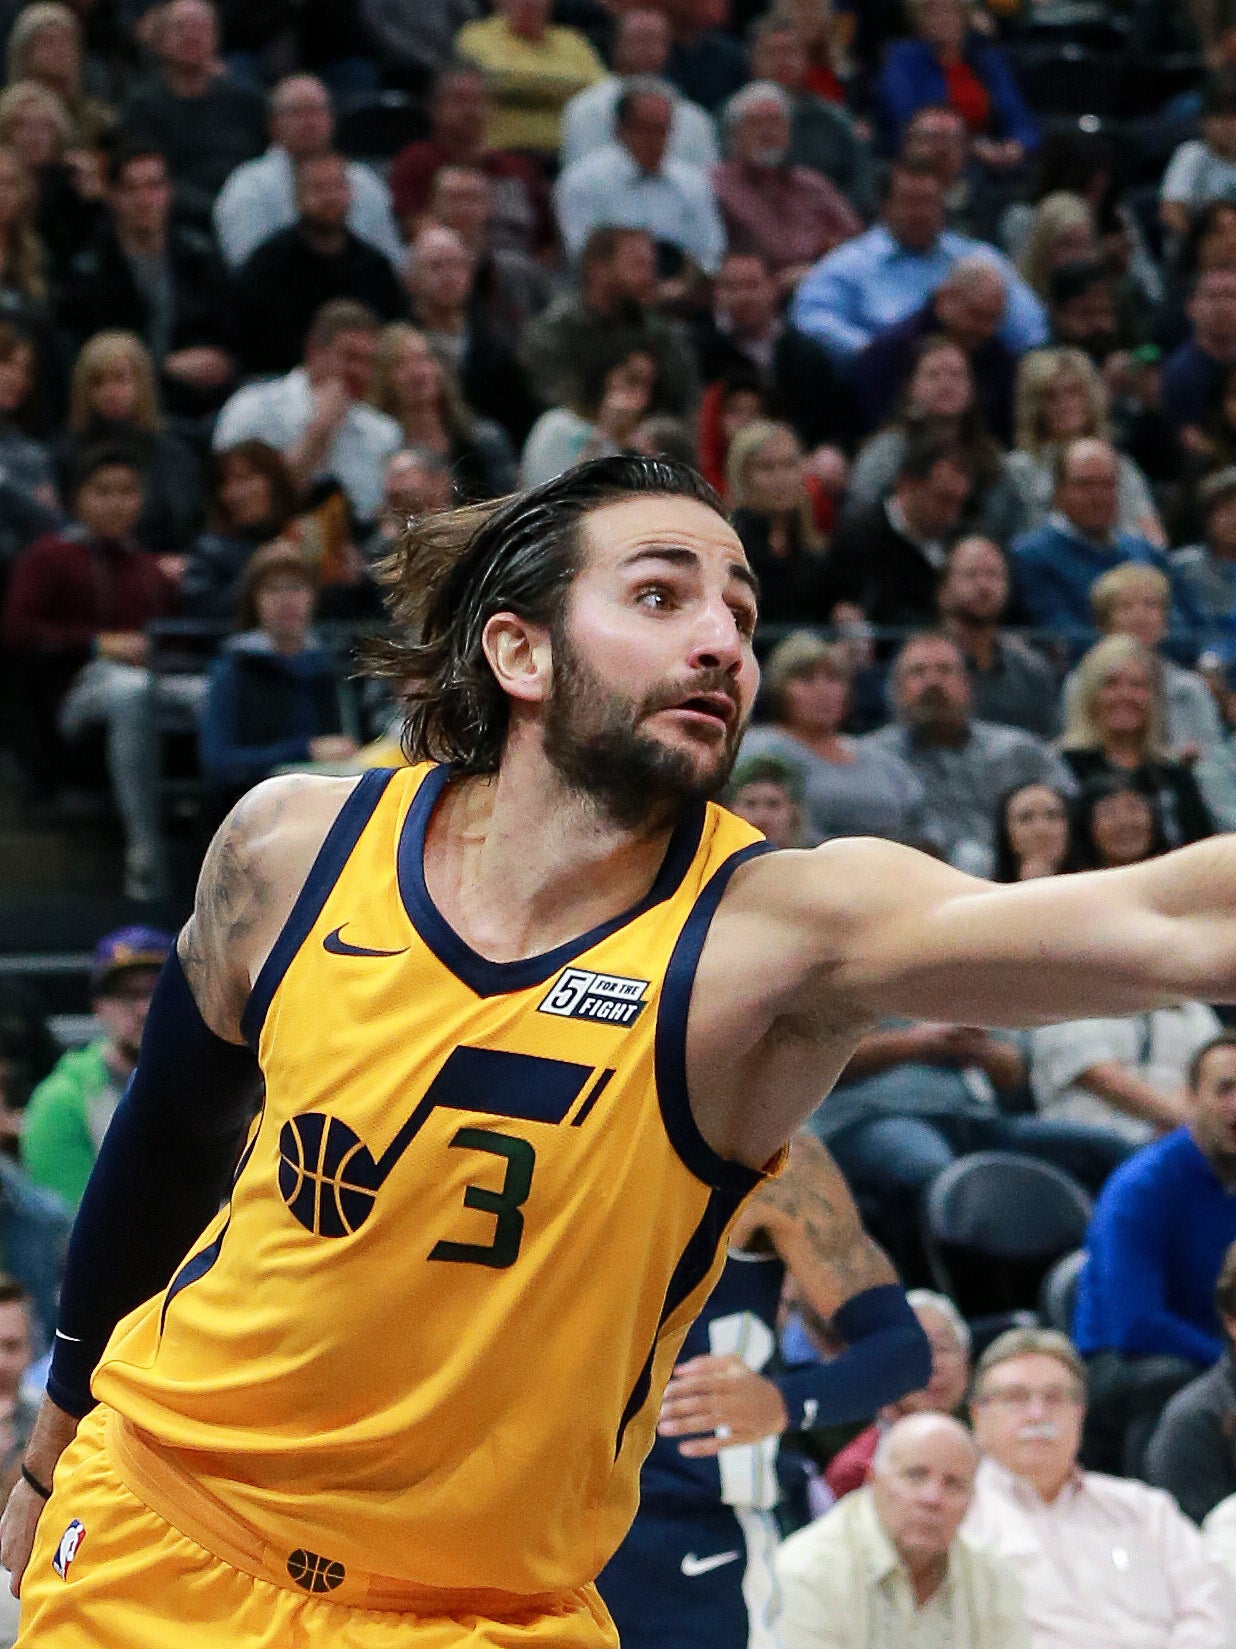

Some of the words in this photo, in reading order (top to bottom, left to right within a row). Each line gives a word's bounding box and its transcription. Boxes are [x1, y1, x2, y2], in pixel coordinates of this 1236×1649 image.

[551, 974, 588, 1009] 5
[596, 980, 618, 993] FOR
[619, 984, 640, 996] THE
[578, 997, 638, 1022] FIGHT
[426, 1127, 536, 1268] 3
